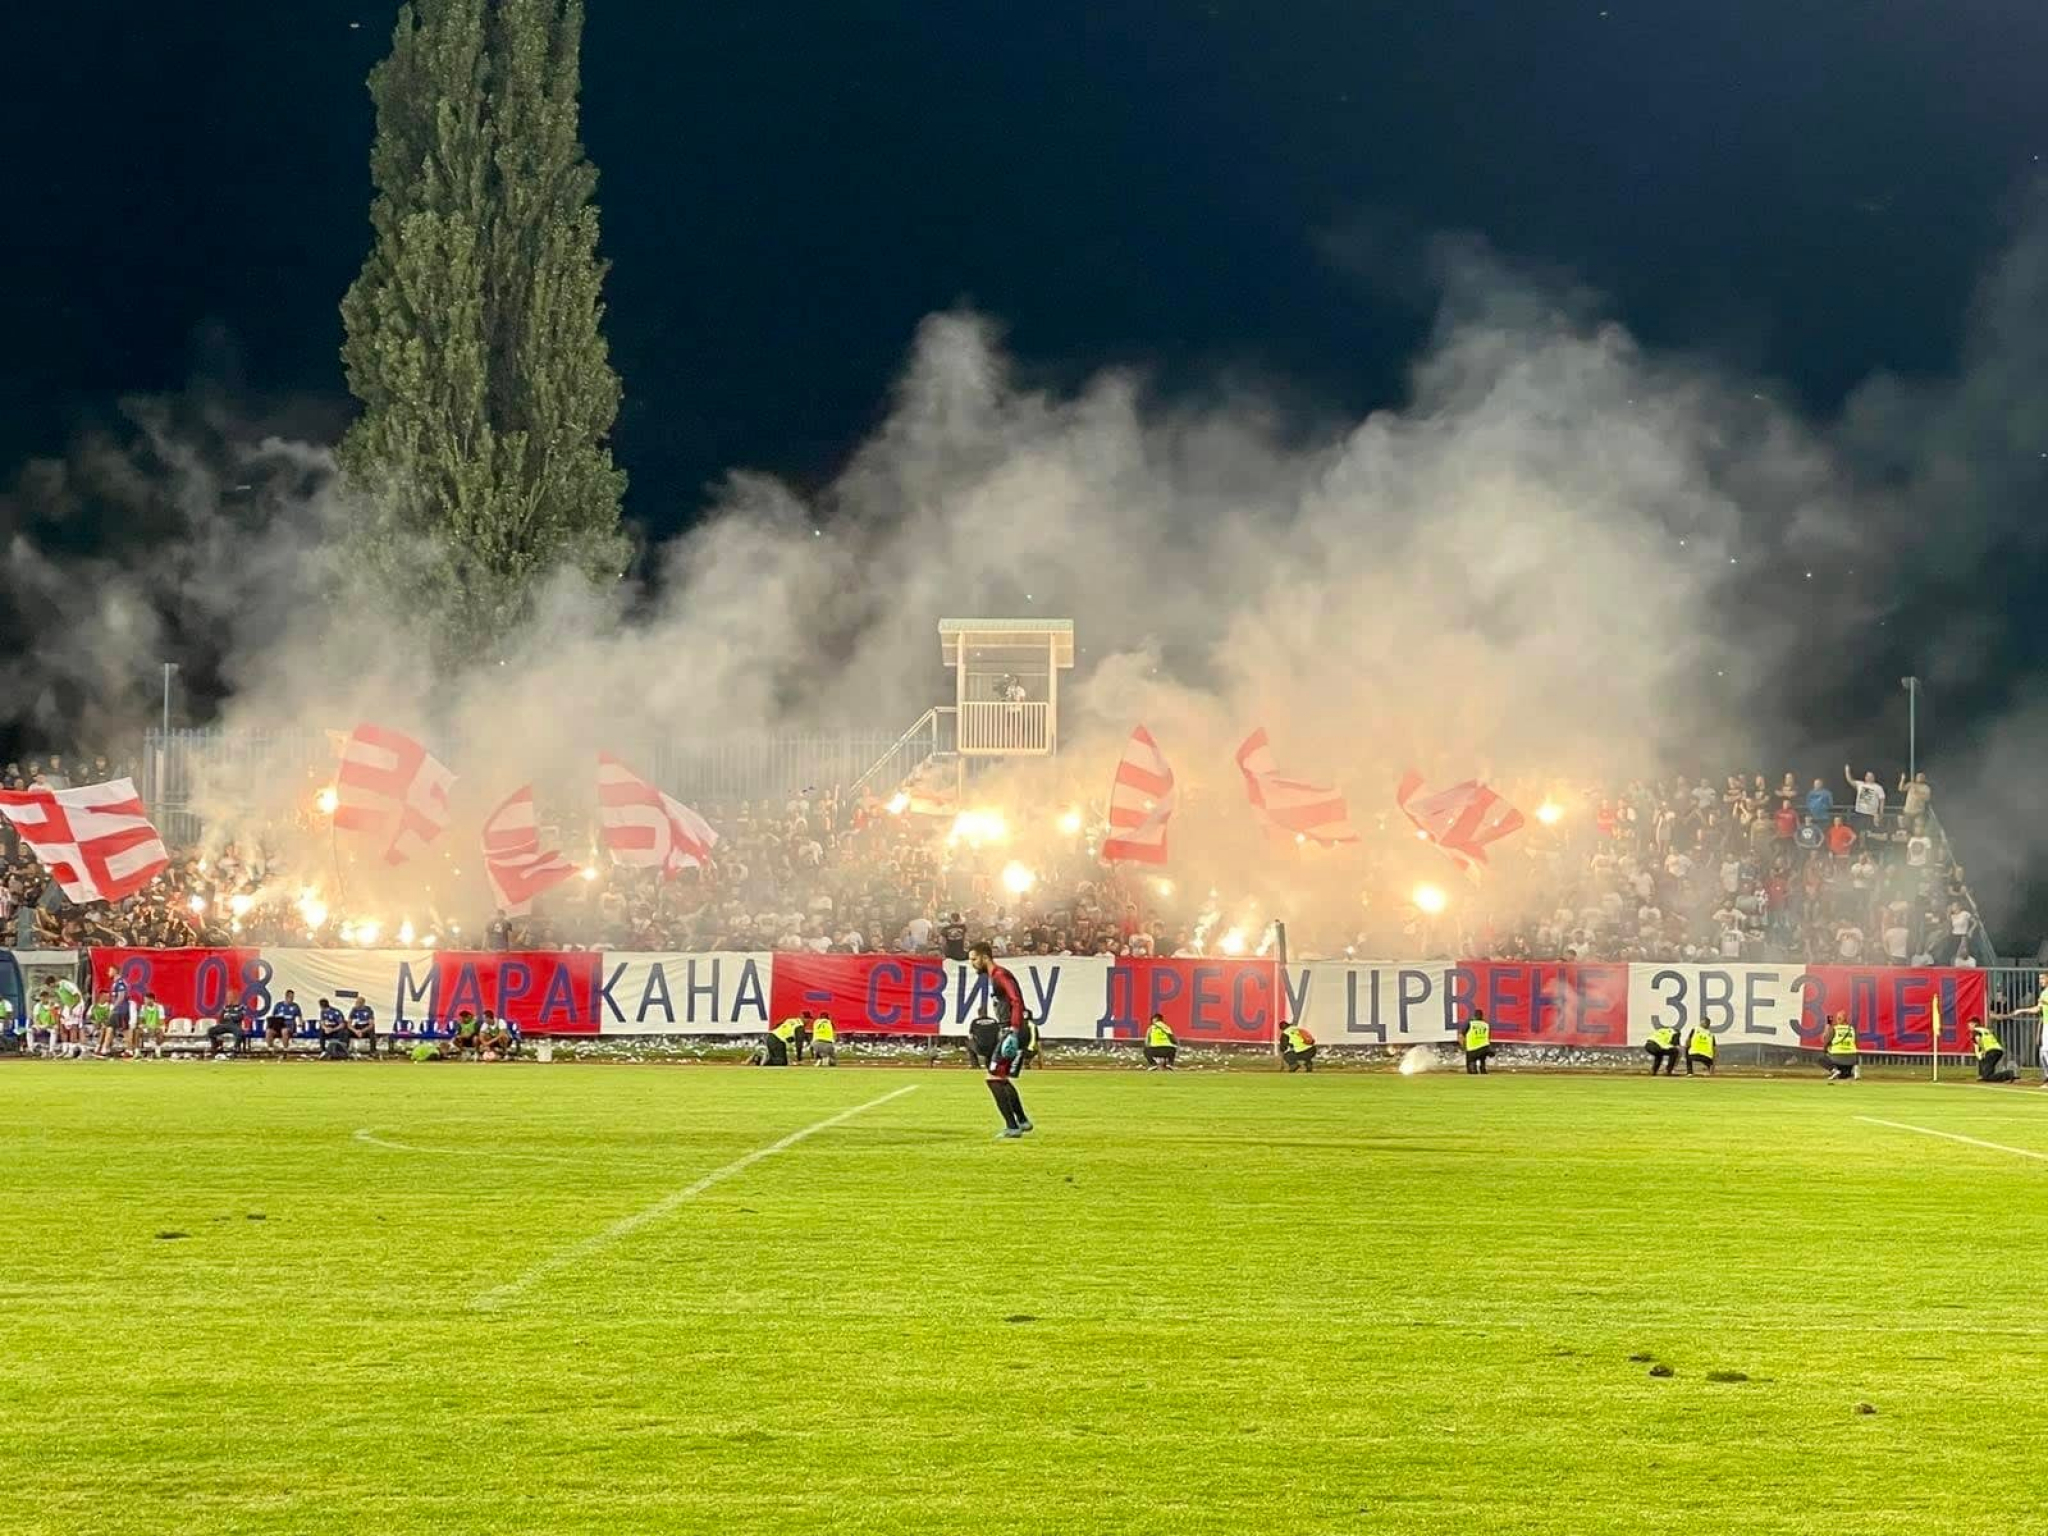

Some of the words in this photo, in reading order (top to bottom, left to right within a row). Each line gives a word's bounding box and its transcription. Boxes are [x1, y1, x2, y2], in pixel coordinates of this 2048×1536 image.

[397, 959, 768, 1023] МАРАКАНА
[867, 963, 989, 1025] СВИ
[1096, 966, 1311, 1038] ДРЕСУ
[1347, 968, 1610, 1042] ЦРВЕНЕ
[1650, 970, 1957, 1051] ЗВЕЗДЕ!
